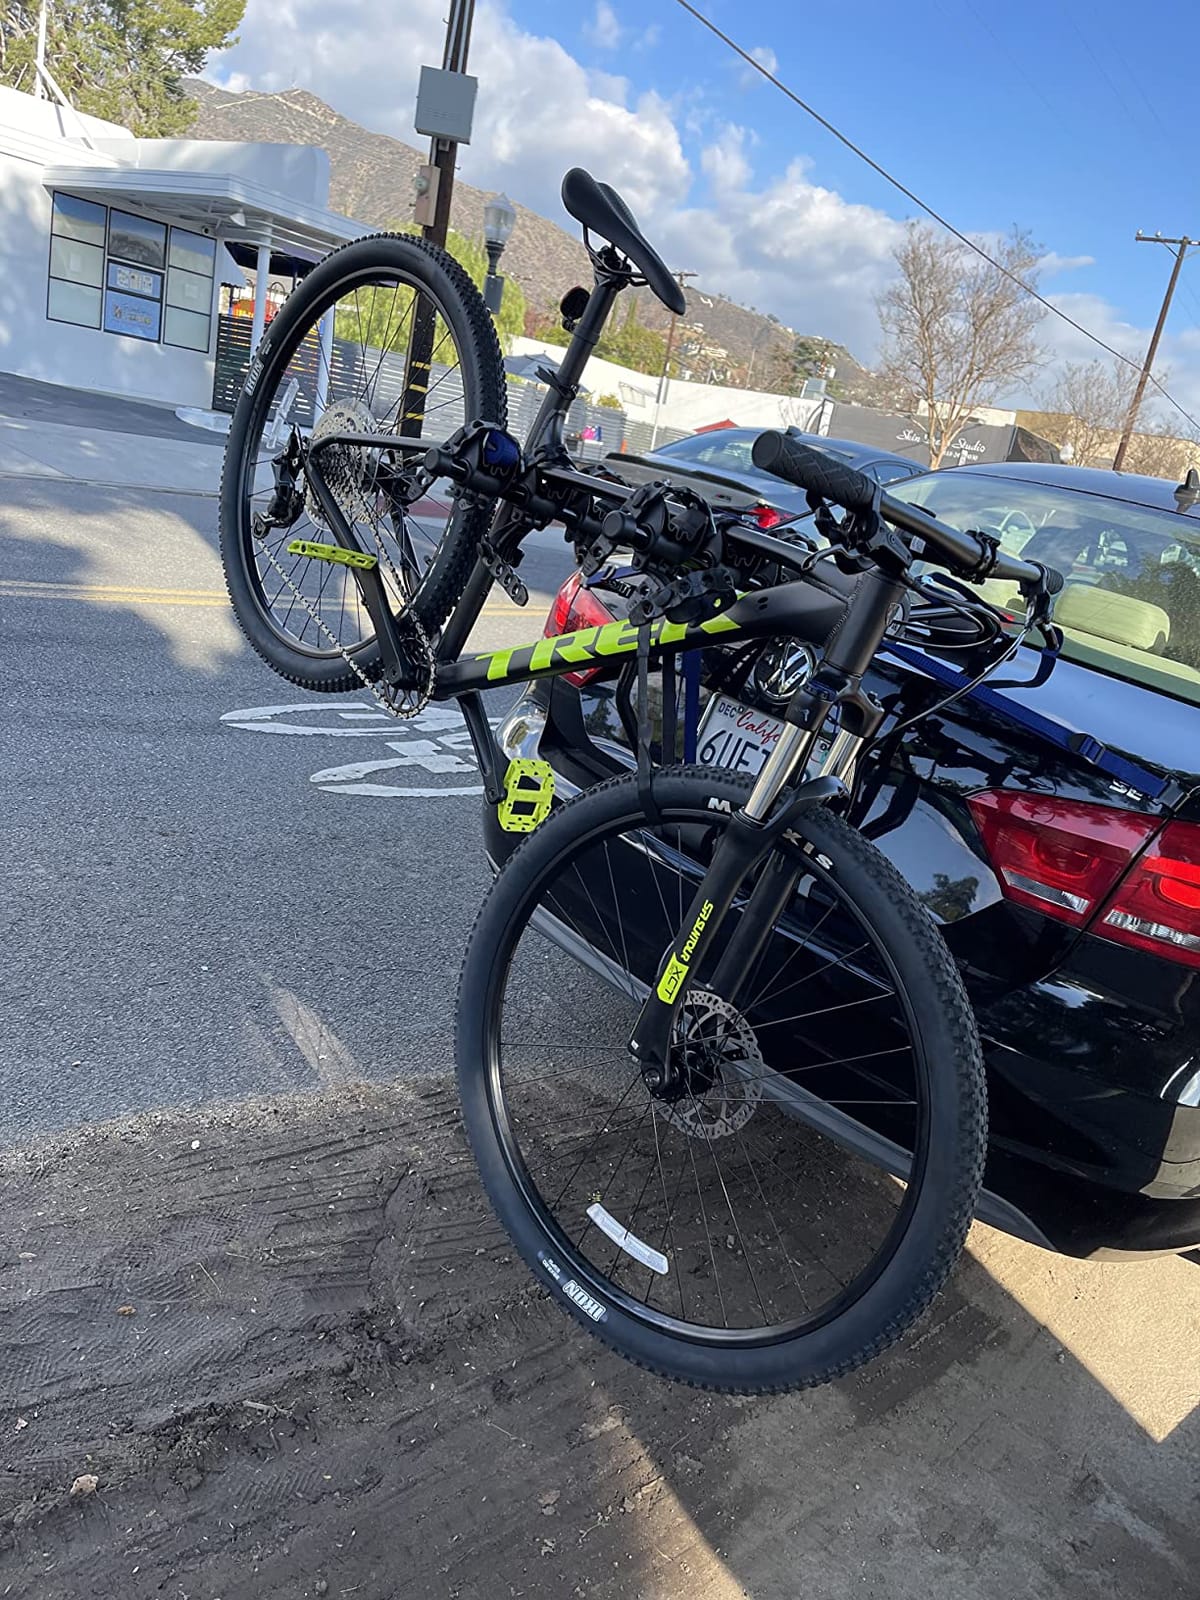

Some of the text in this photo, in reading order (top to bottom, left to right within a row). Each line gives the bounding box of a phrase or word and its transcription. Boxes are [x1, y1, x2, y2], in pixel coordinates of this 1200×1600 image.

[951, 438, 986, 453] Studio
[718, 702, 737, 718] DEC
[680, 917, 706, 962] SUNTOUR
[664, 966, 683, 1000] XCT
[562, 1279, 607, 1322] IKON
